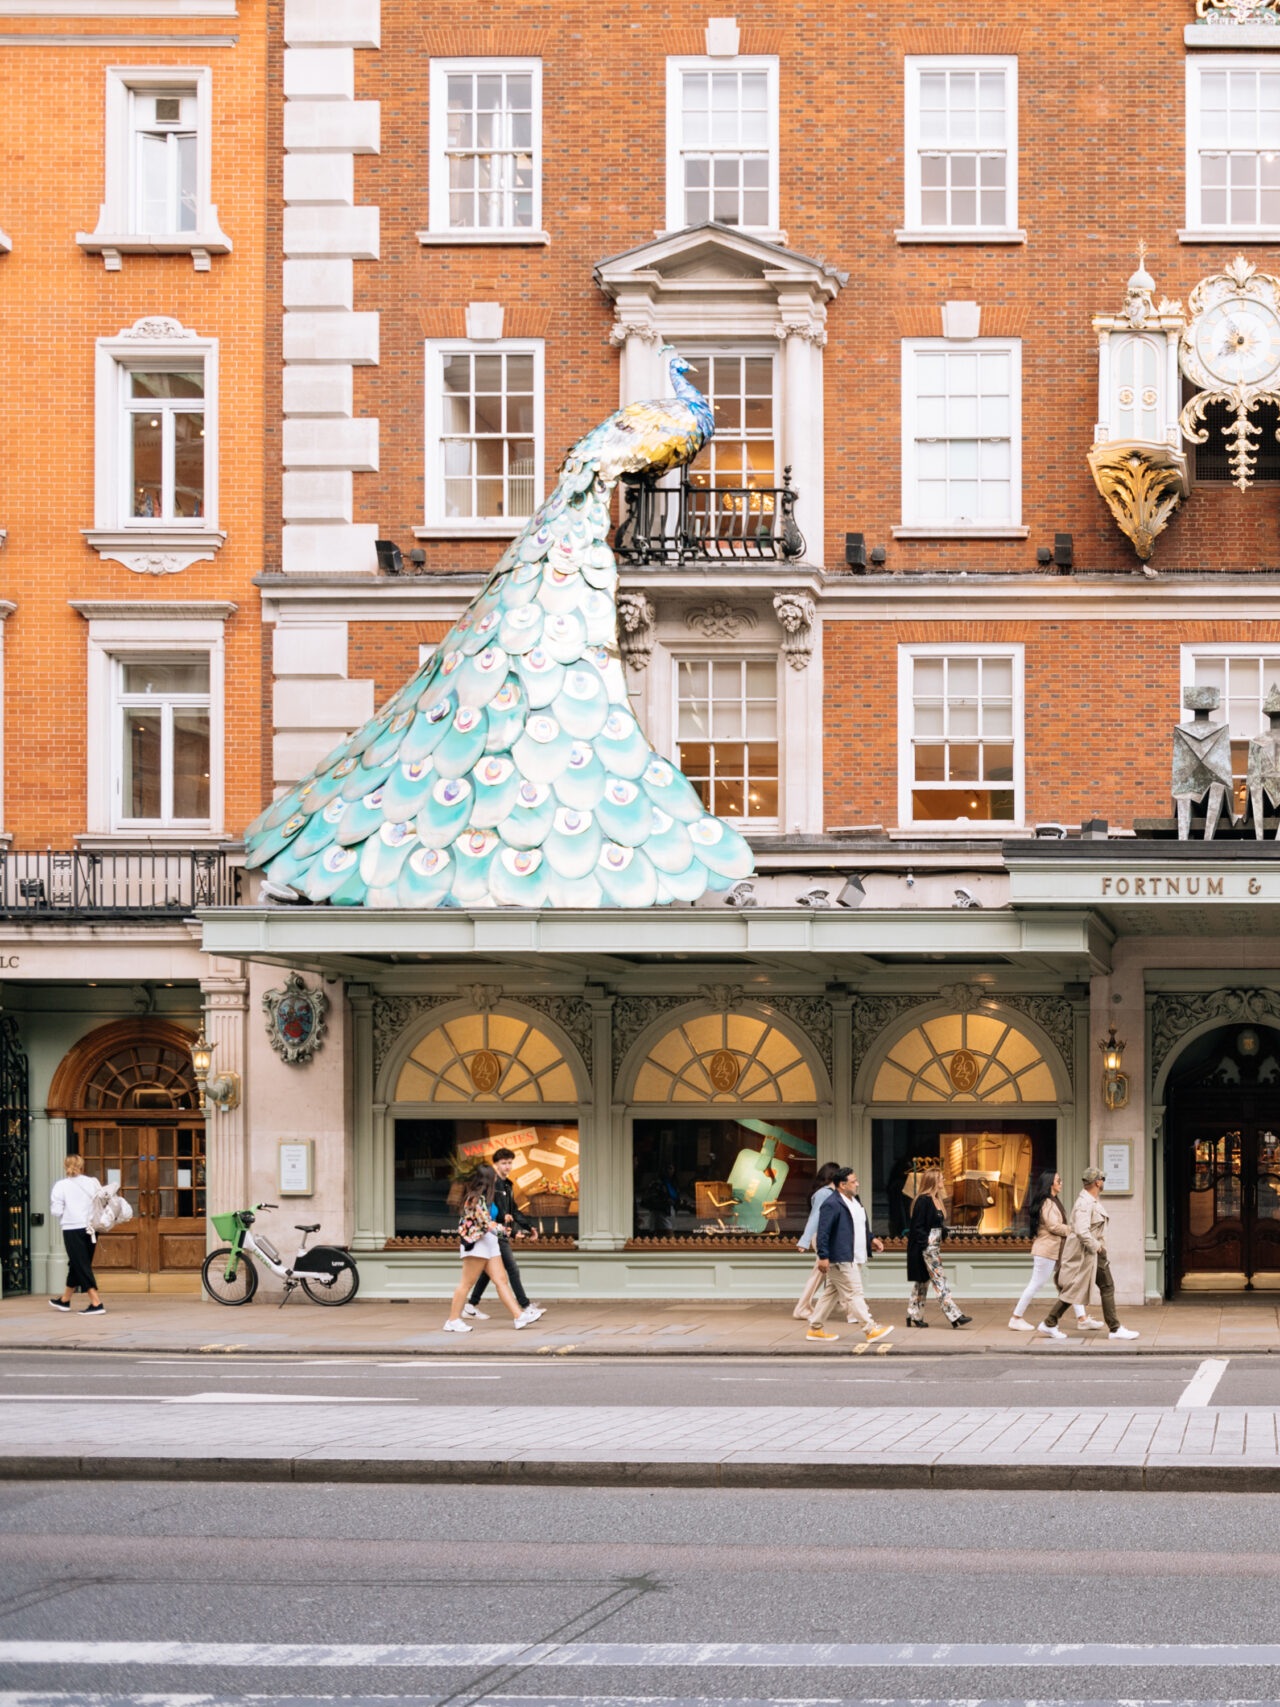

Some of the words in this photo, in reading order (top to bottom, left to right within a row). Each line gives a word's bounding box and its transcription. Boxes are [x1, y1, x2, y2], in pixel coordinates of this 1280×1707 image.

[1102, 877, 1224, 896] FORTNUM
[1247, 877, 1262, 896] &
[463, 1131, 534, 1157] VACANCIES
